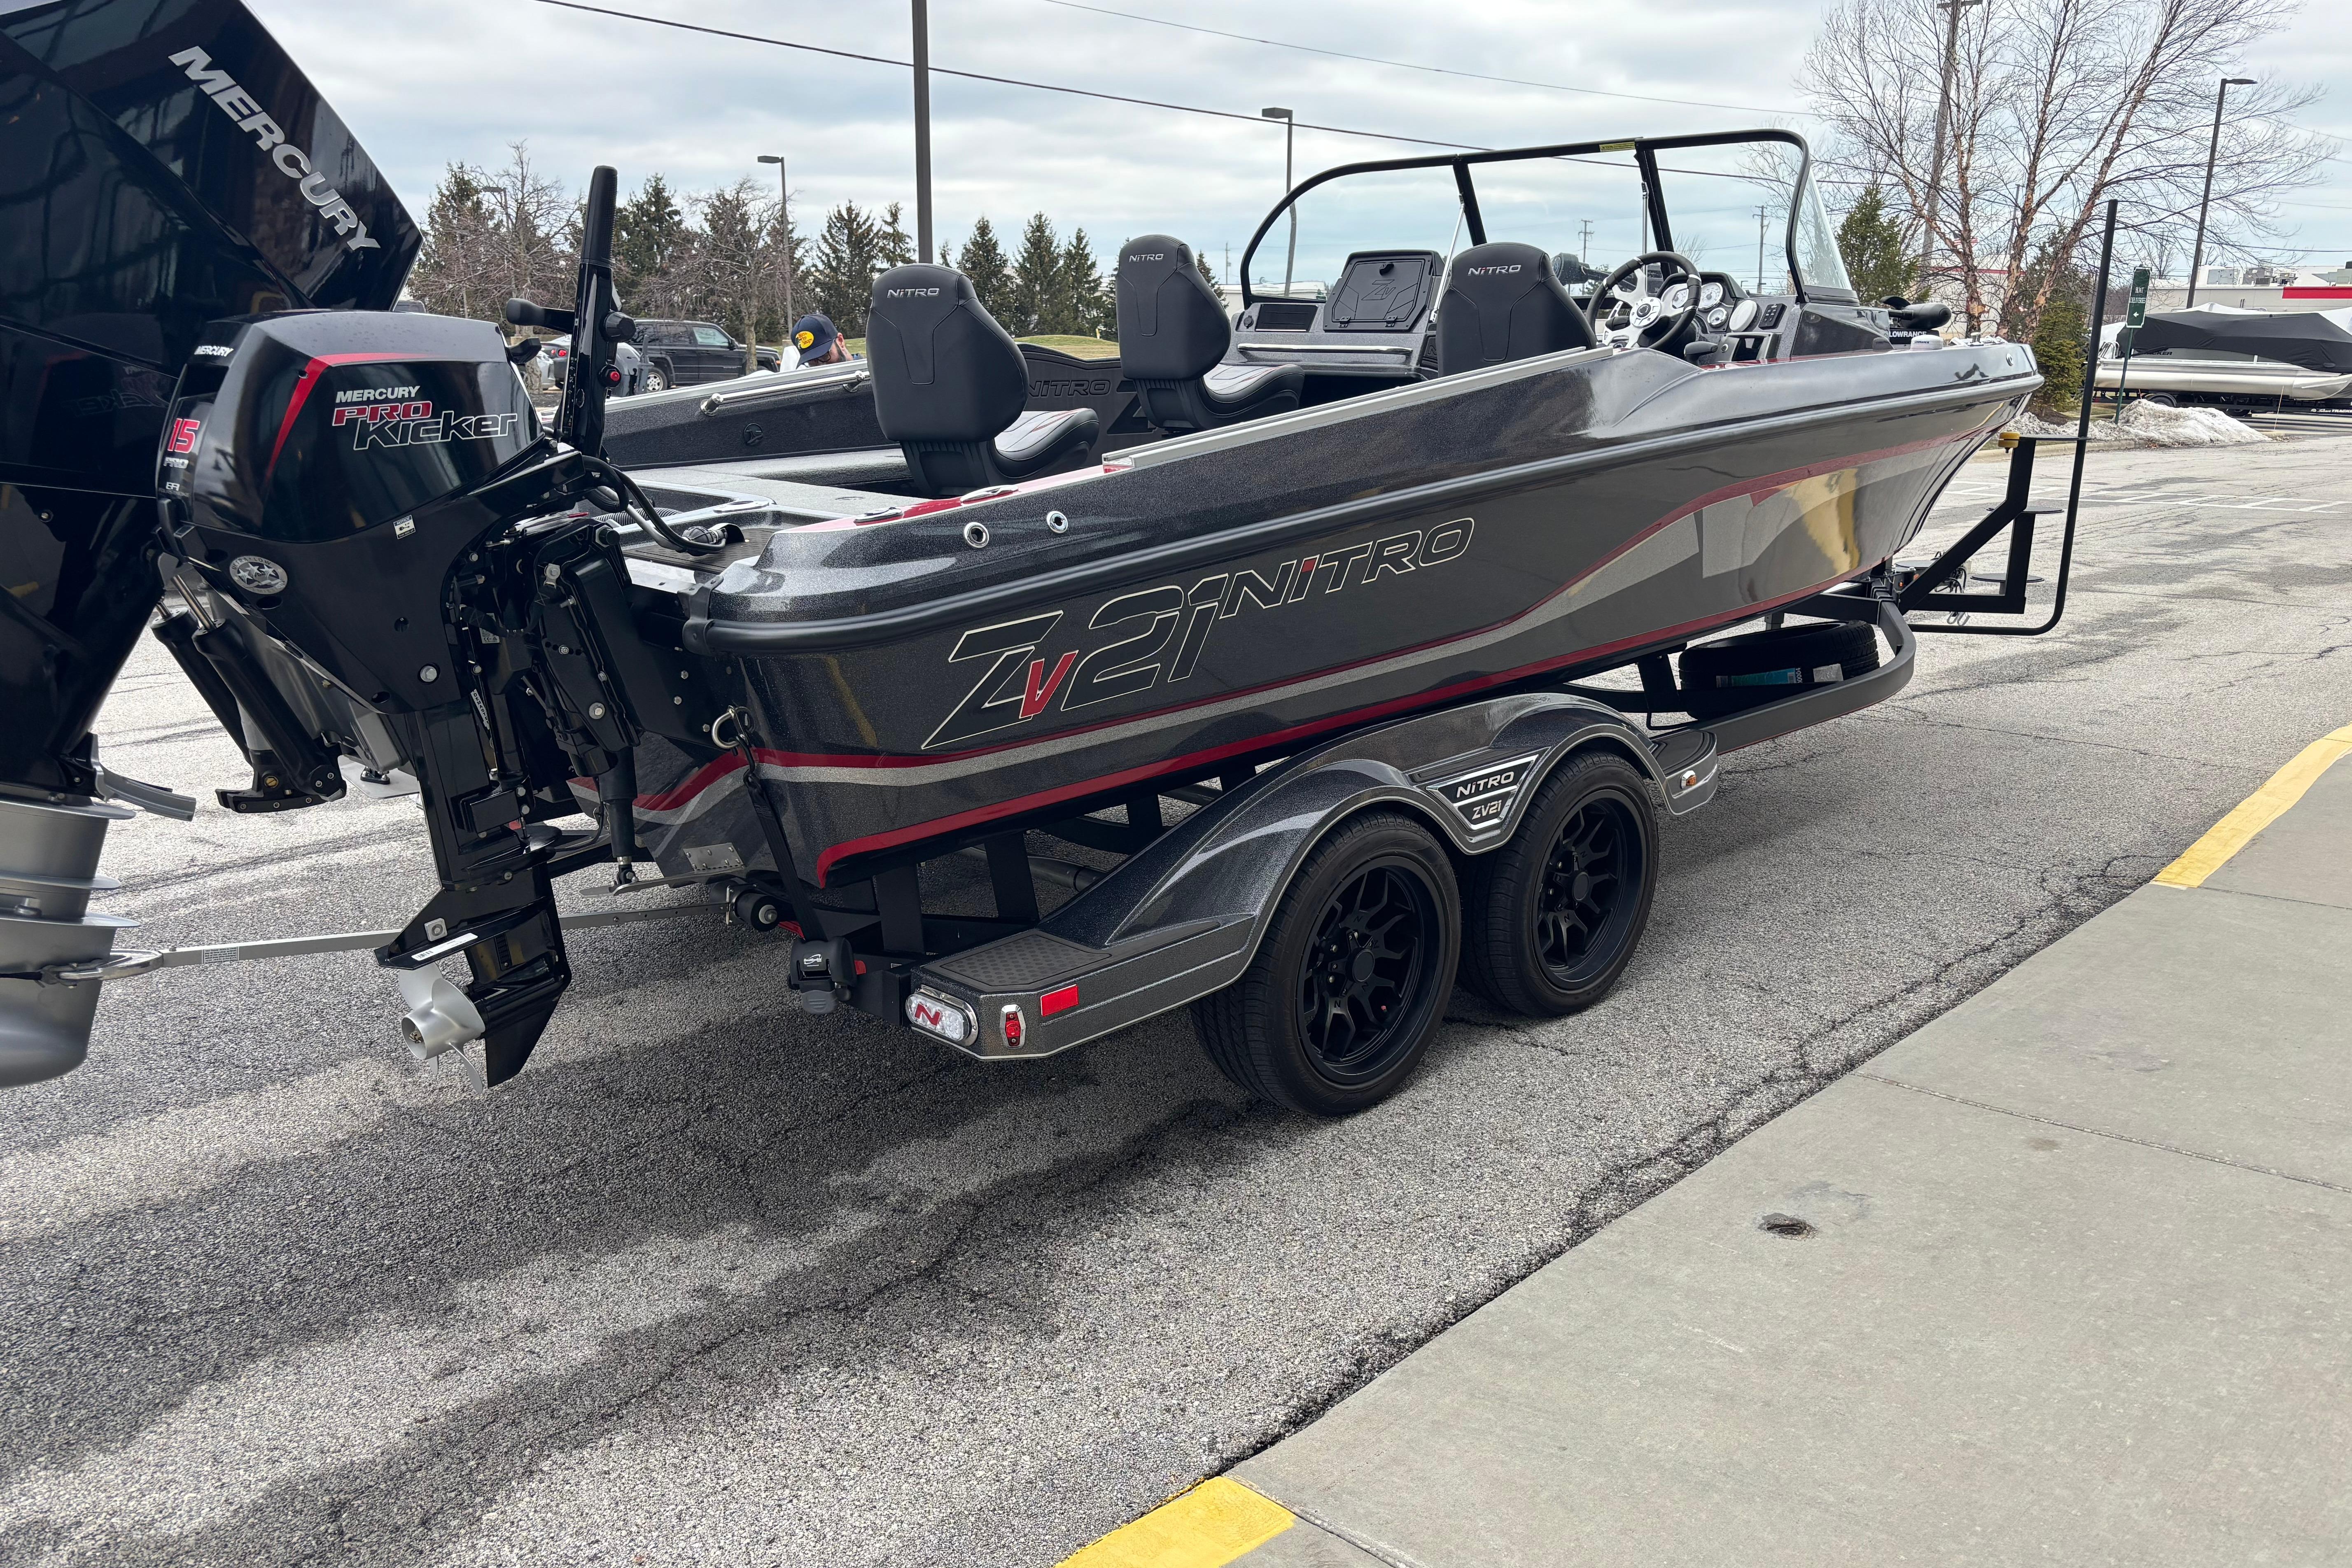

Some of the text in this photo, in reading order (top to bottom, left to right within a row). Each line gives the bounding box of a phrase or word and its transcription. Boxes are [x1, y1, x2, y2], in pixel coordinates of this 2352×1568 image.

[168, 46, 381, 251] MERCURY
[194, 345, 234, 357] MERCURY
[336, 385, 420, 403] MERCURY
[332, 401, 432, 426] PRO
[167, 418, 201, 453] 15
[353, 411, 518, 450] Kicker
[163, 457, 189, 469] PRO
[1472, 800, 1502, 820] ZV21
